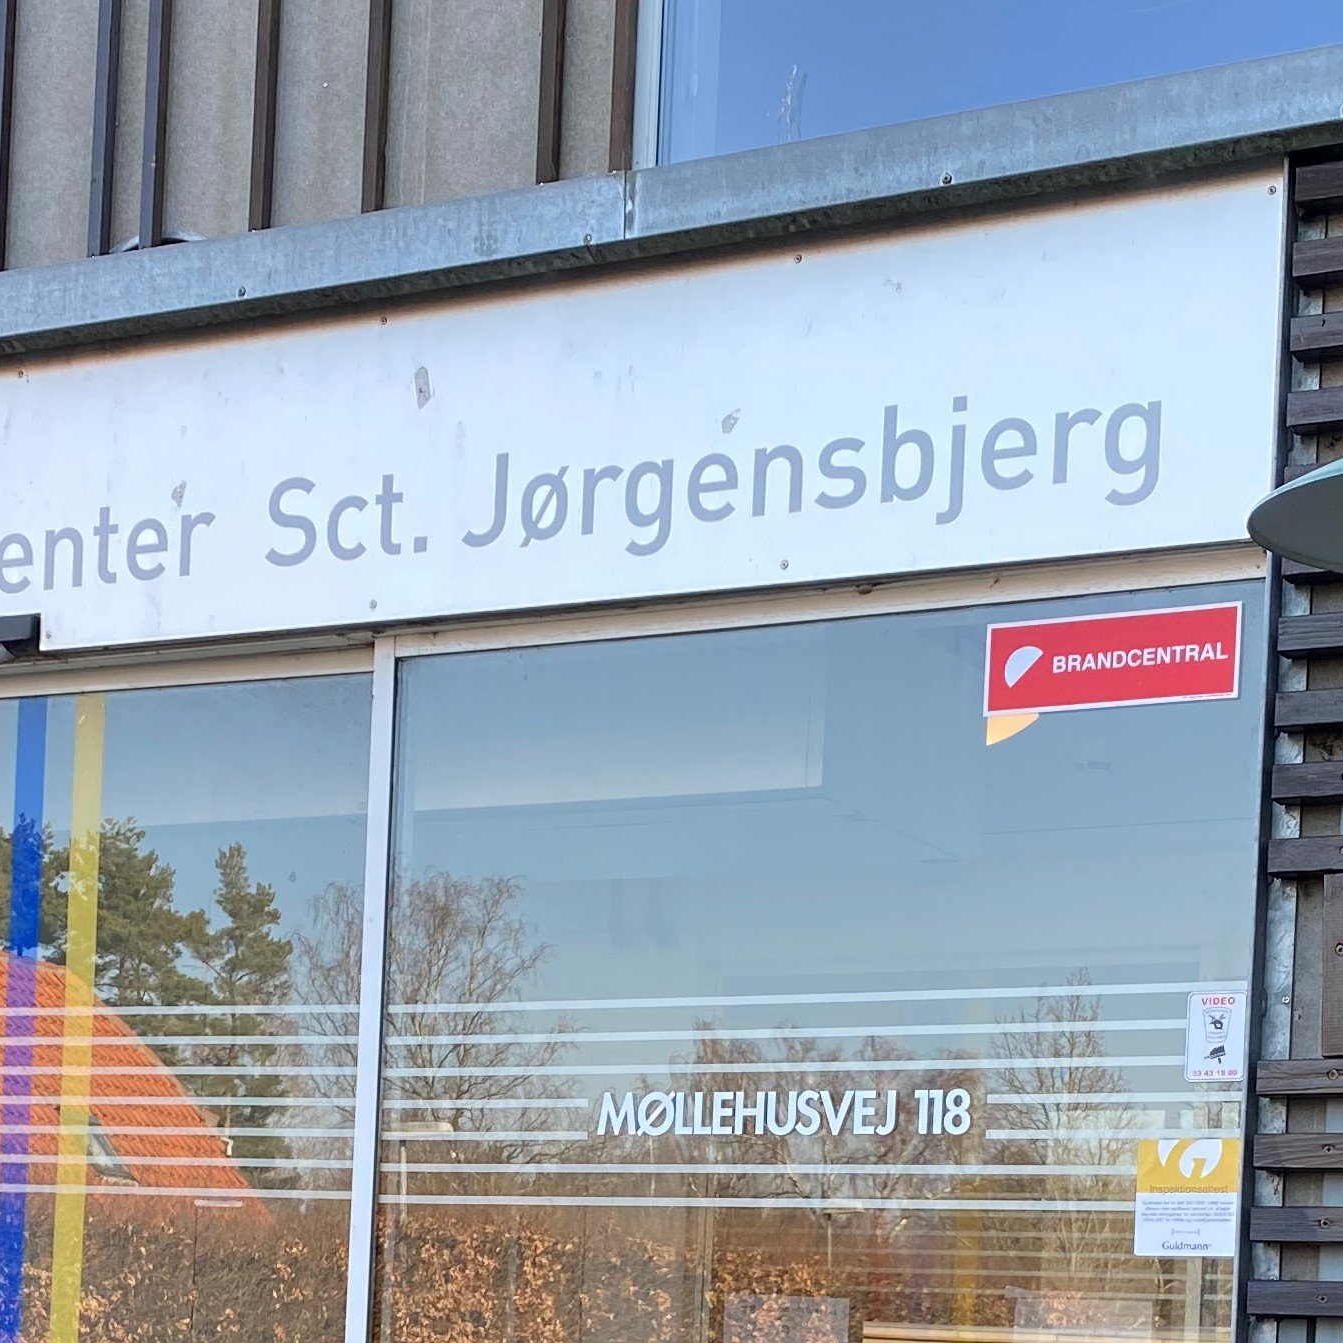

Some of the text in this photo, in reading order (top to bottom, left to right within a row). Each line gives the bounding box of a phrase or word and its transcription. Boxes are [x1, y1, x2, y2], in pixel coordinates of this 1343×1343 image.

[264, 473, 429, 569] Sct.
[460, 396, 1162, 557] Jørgensbjerg
[1052, 641, 1229, 674] BRANDCENTRAL
[1201, 996, 1236, 1005] VIDEO
[597, 1088, 972, 1137] MØLLEHUSVEJ 118
